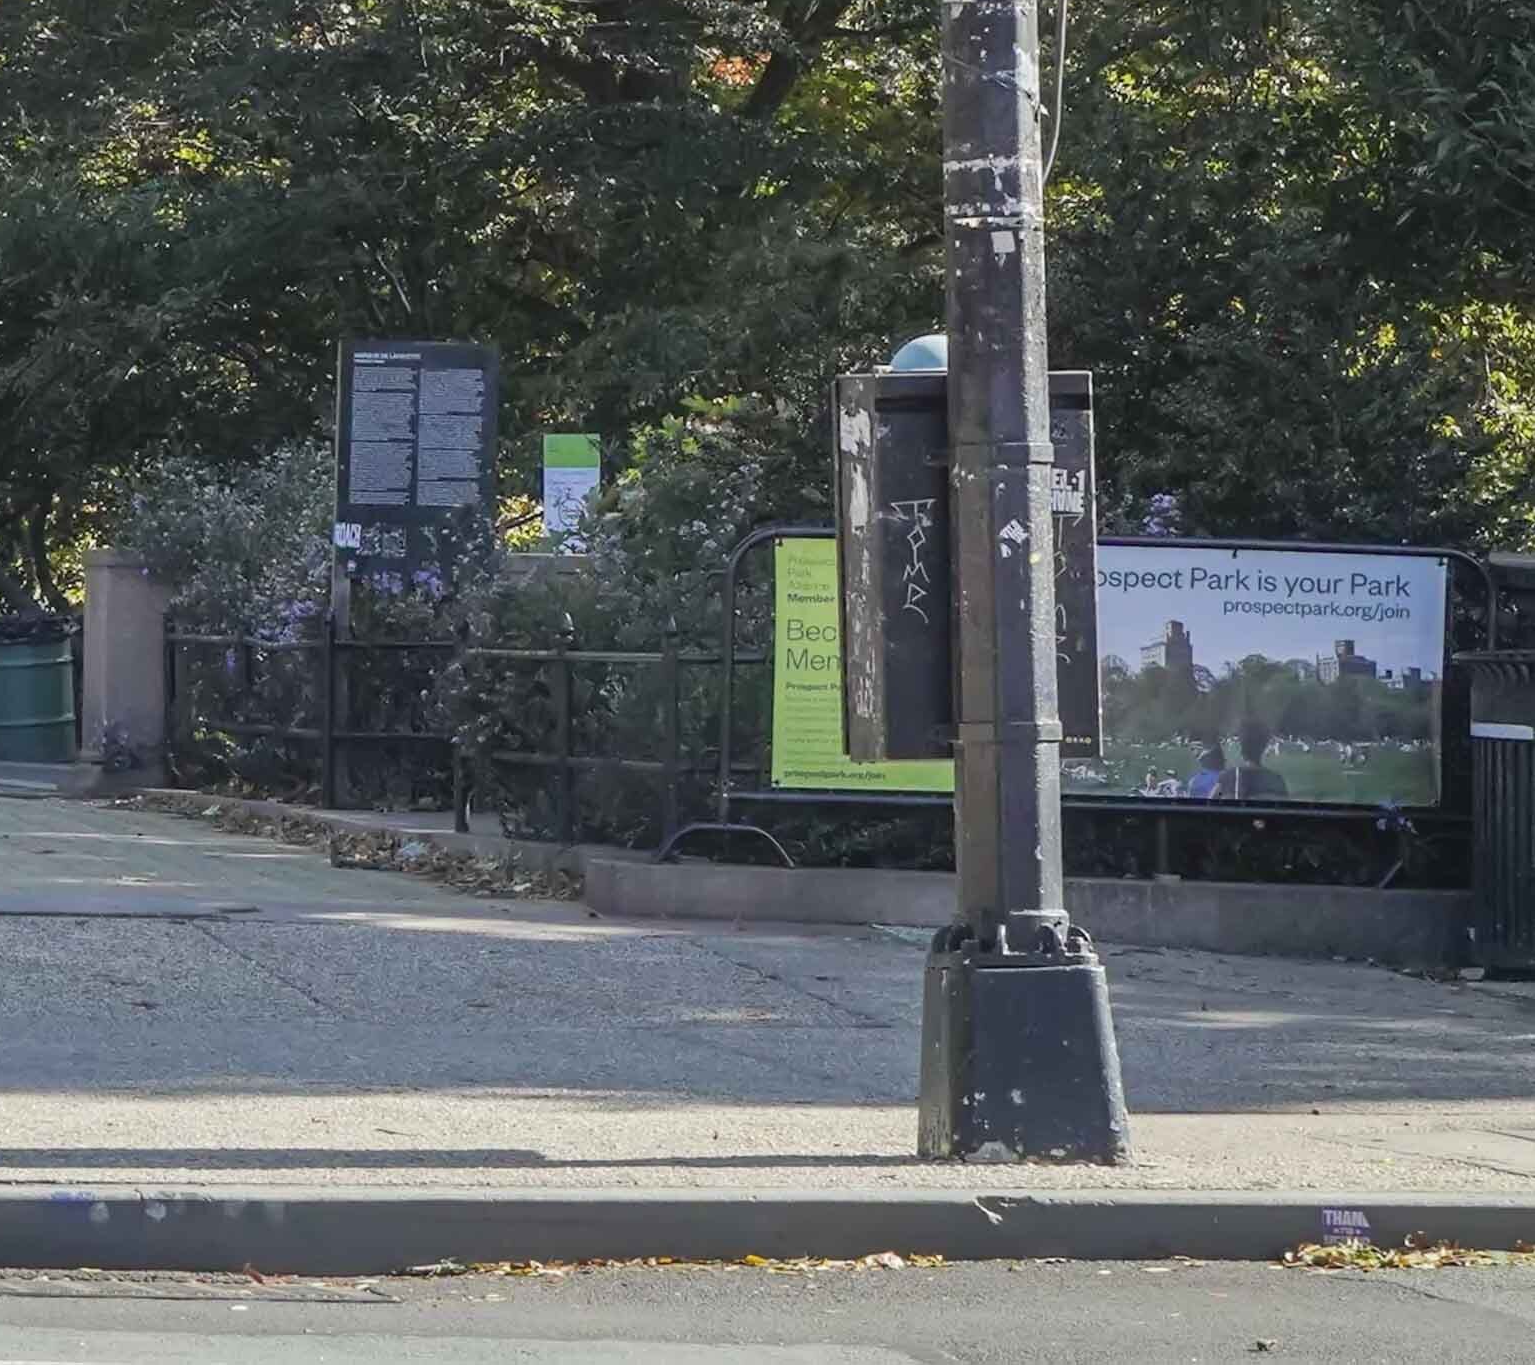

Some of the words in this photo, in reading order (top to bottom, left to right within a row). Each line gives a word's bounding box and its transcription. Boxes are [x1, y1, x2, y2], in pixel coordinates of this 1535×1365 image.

[1190, 567, 1250, 592] Park
[1258, 569, 1277, 592] is
[1285, 576, 1343, 599] your
[1350, 573, 1411, 598] Park
[1223, 599, 1411, 622] prospectpark.org/join
